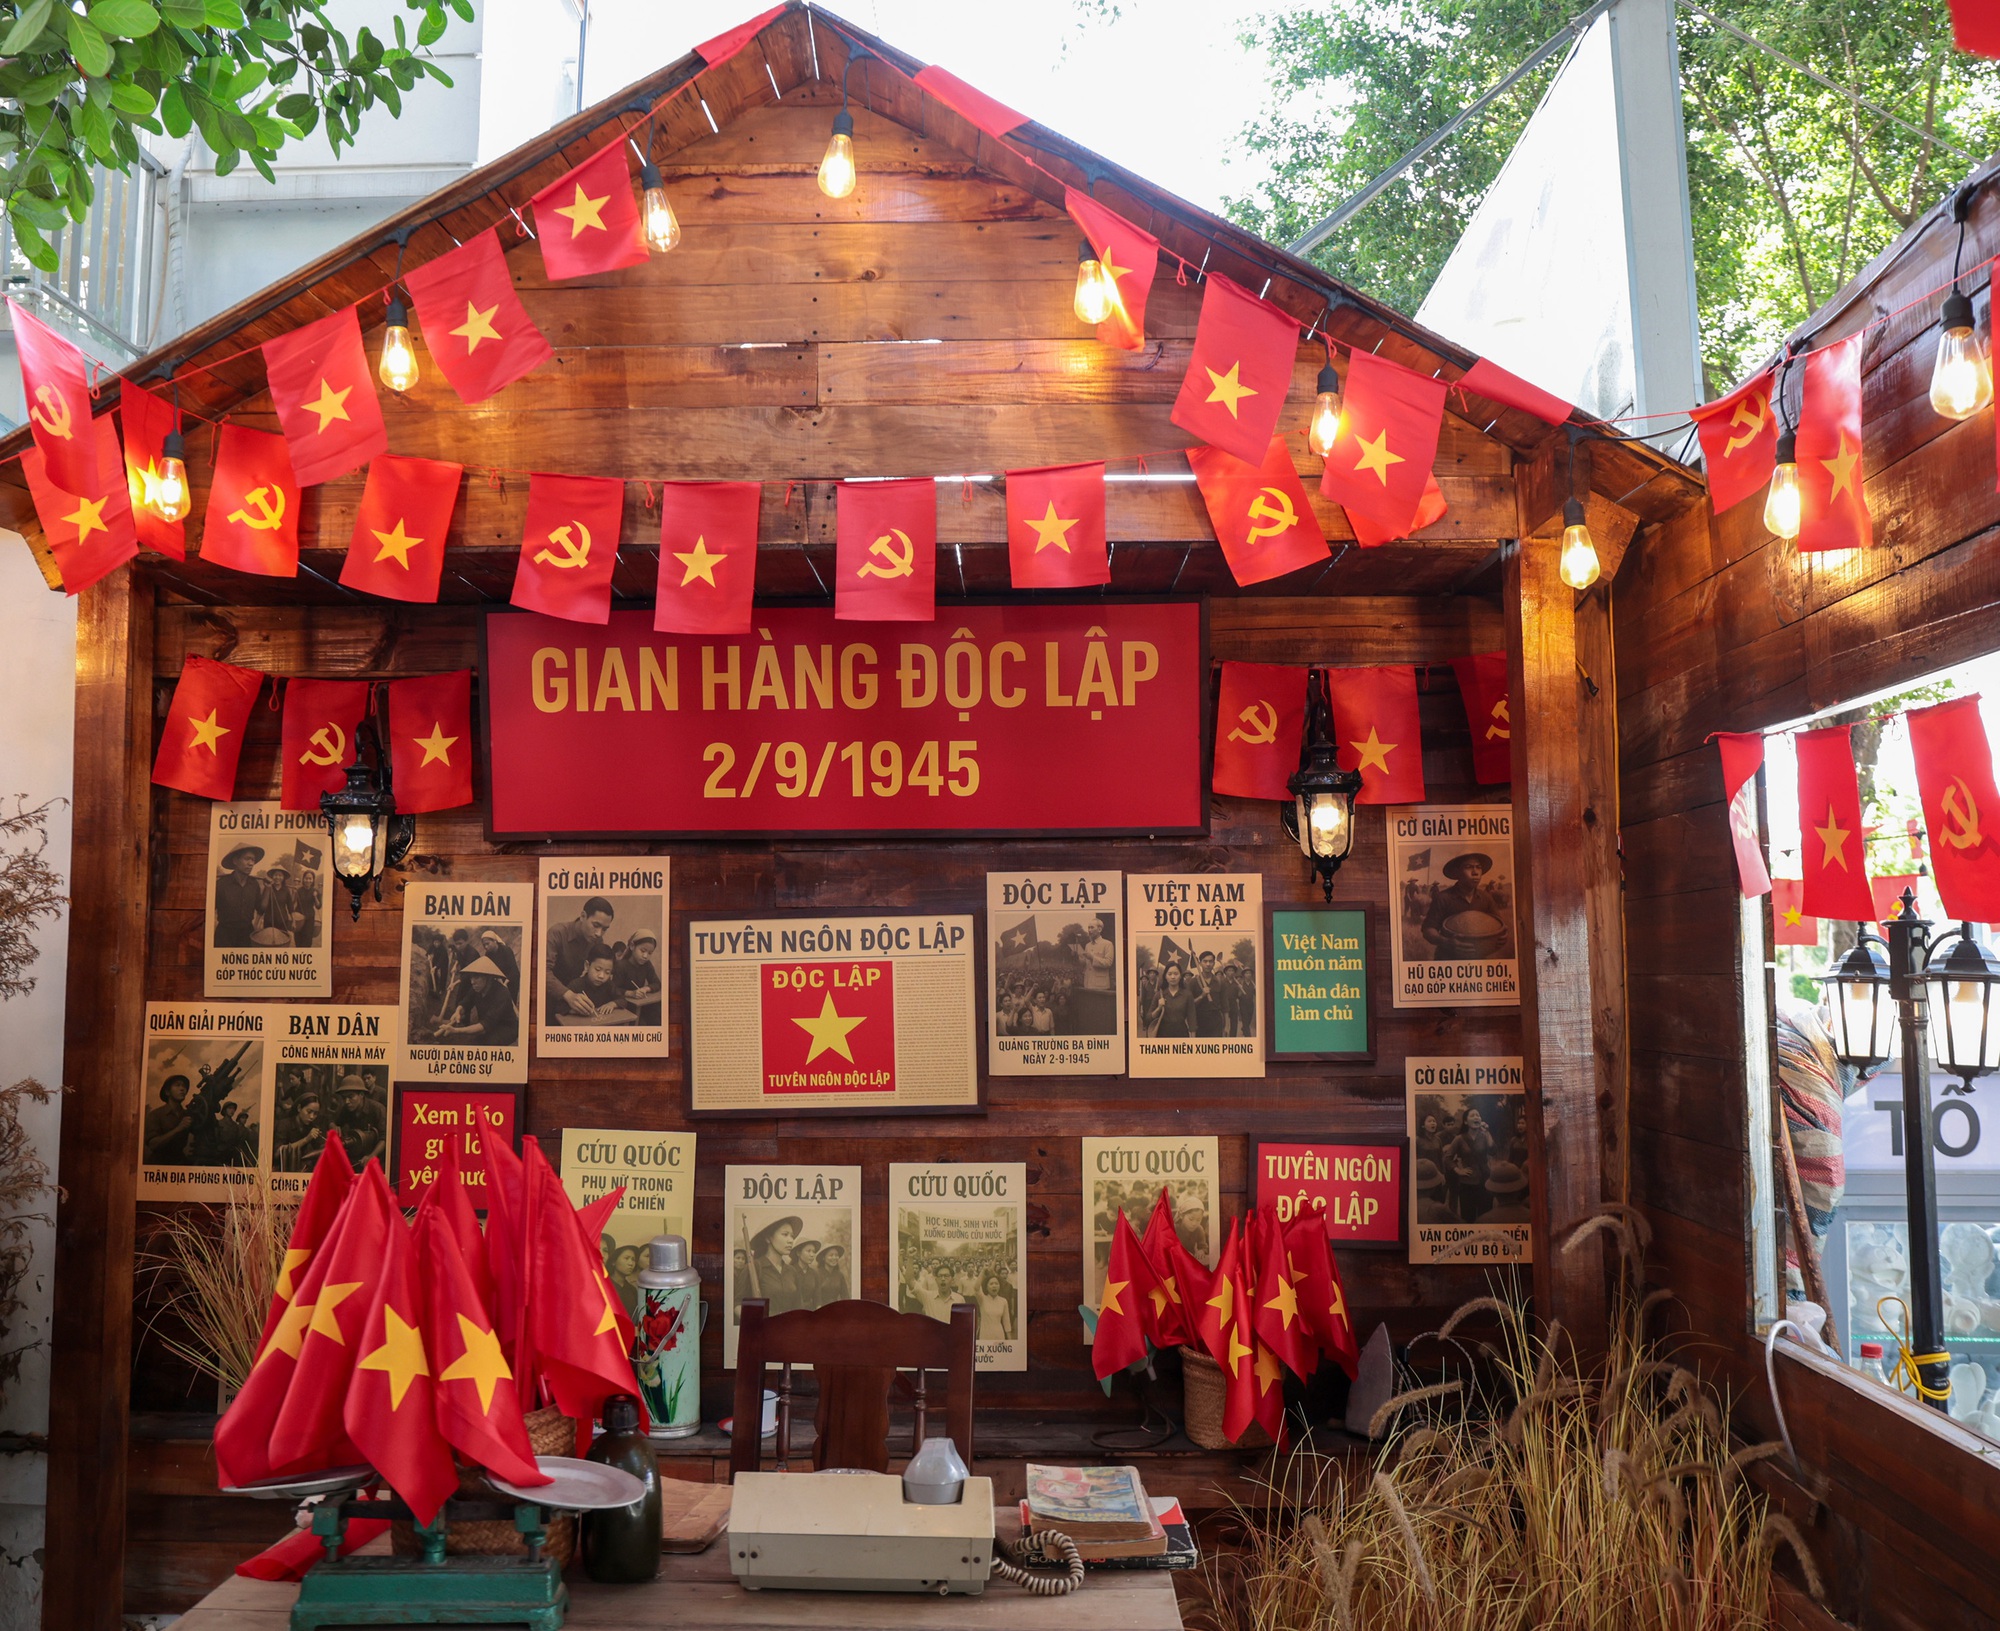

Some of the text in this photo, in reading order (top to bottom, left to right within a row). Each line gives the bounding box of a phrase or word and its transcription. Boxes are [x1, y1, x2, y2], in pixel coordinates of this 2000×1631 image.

[532, 625, 1159, 721] GIAN HÀNG ĐỘC LẬP
[703, 740, 979, 798] 2/9/1945
[219, 808, 327, 829] CỜ GIẢI PHÓNG
[1396, 814, 1509, 836] CỜ GIẢI PHÓNG
[548, 866, 662, 889] CỜ GIẢI PHÓNG
[1002, 877, 1106, 909] ĐỘC LẬP
[1142, 879, 1245, 907] VIỆT NAM
[424, 890, 510, 919] BẠN DÂN
[1154, 903, 1237, 930] ĐỘC LẬP
[694, 921, 964, 954] TUYÊN NGÔN ĐỘC LẬP
[1281, 933, 1358, 953] Việt Nam
[221, 951, 312, 964] NÔNG DÂN NÔ NỨC
[1277, 954, 1362, 970] muôn năm
[215, 967, 316, 980] GÓP THÓC CỨU NƯỚC
[772, 964, 880, 992] ĐỘC LẬP
[1407, 962, 1512, 980] HŨ GẠO CỨU ĐÓI,
[1283, 982, 1360, 999] Nhân dân
[1404, 978, 1516, 996] GẠO GÓP KHÁNG CHIẾN
[149, 1008, 262, 1031] QUÂN GIẢI PHÓNG
[1291, 1004, 1353, 1020] làm chủ
[288, 1011, 379, 1039] BẠN DÂN
[545, 1031, 663, 1044] PHONG TRÀO XOÁ NẠN MÙ CHỮ
[1031, 1037, 1070, 1052] TRƯỜNG
[1071, 1039, 1085, 1051] BA
[1086, 1037, 1111, 1051] ĐÌNH
[281, 1044, 385, 1059] CÔNG NHÂN NHÀ MÁY
[409, 1049, 442, 1062] NGƯỜI
[443, 1048, 465, 1061] DÂN
[466, 1048, 489, 1062] ĐÀO
[1139, 1042, 1253, 1054] THANH NIÊN XUNG PHONG
[1022, 1052, 1091, 1065] NGÀY 2-9-1945
[427, 1061, 494, 1078] LẬP CÔNG SỰ
[769, 1069, 890, 1087] TUYÊN NGÔN ĐỘC LẬP
[1414, 1063, 1525, 1085] CỜ GIẢI PHÓN
[413, 1103, 458, 1125] Xem
[576, 1139, 680, 1167] CỨU QUỐC
[1096, 1143, 1204, 1175] CỨU QUỐC
[1266, 1150, 1391, 1181] TUYÊN NGÔN
[143, 1170, 169, 1185] TRẬN
[169, 1171, 187, 1186] ĐỊA
[581, 1175, 607, 1192] PHỤ
[632, 1177, 673, 1192] TRONG
[742, 1172, 843, 1204] ĐỘC LẬP
[908, 1169, 1006, 1198] CỨU QUỐC
[629, 1193, 665, 1210] CHIẾN
[1334, 1190, 1378, 1231] LẬP
[1420, 1229, 1441, 1242] VĂN
[1502, 1244, 1522, 1256] ĐI
